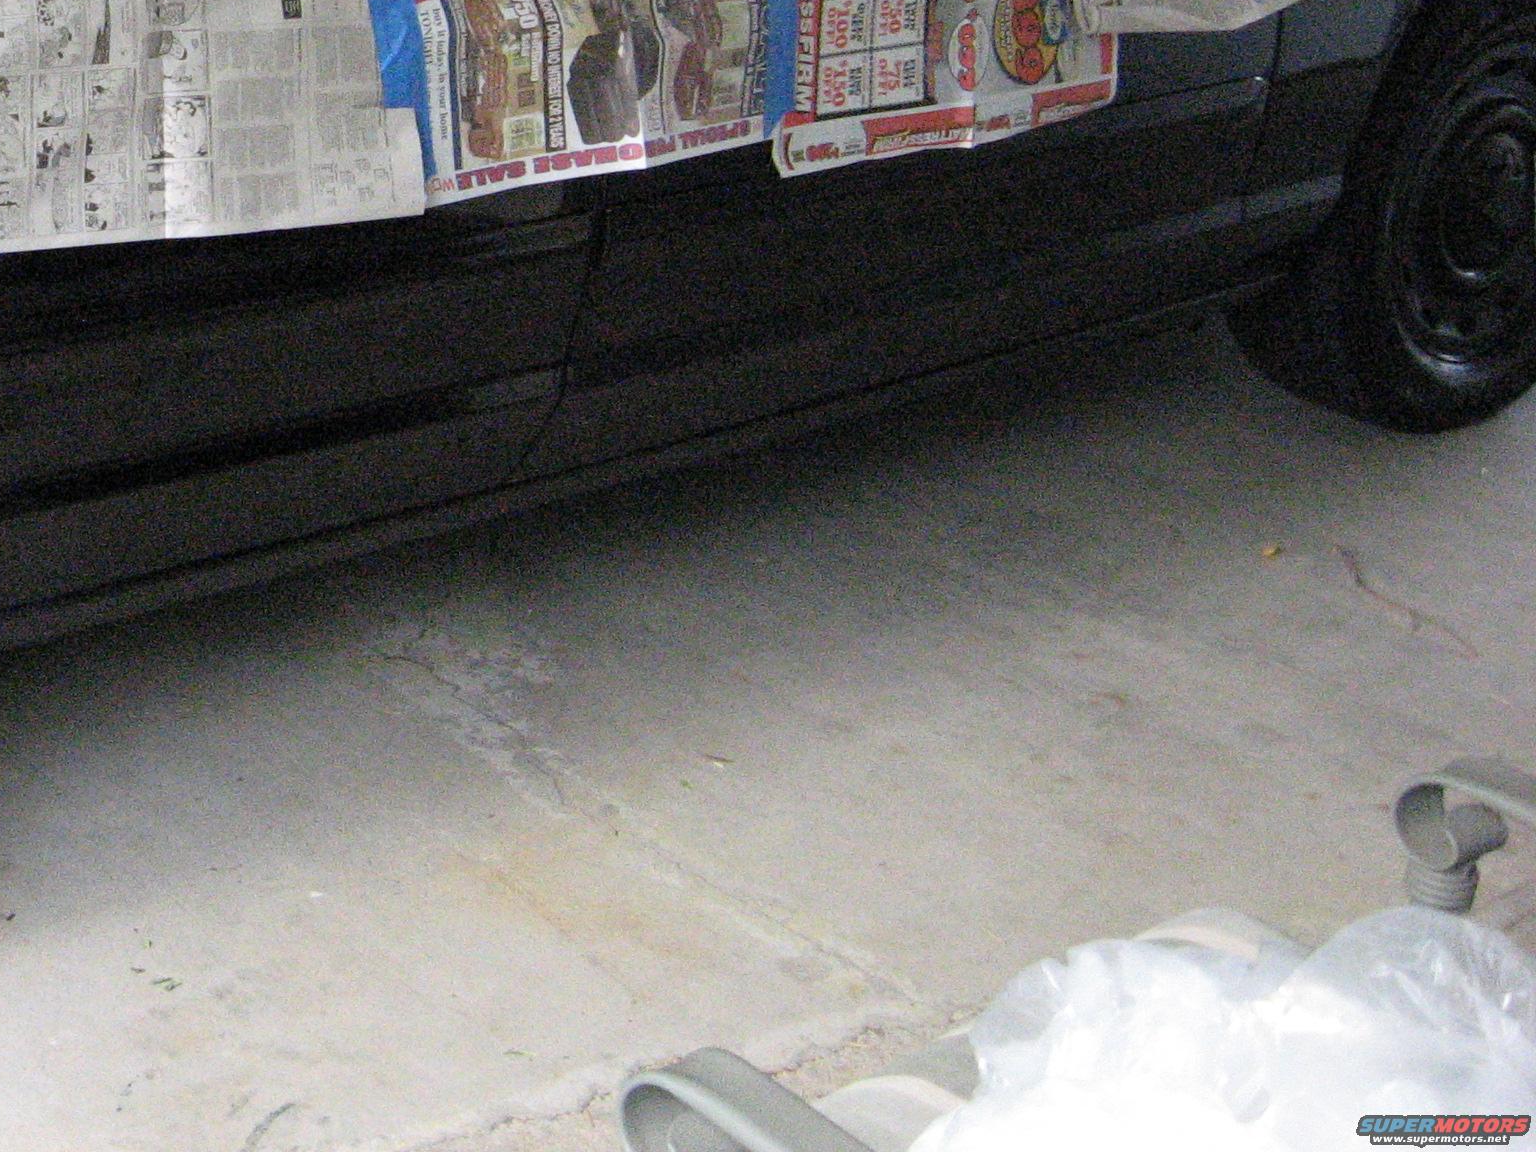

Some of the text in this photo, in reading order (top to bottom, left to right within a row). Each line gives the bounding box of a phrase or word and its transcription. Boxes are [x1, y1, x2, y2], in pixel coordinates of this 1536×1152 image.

[544, 22, 563, 50] DOWN
[831, 0, 854, 50] $100
[546, 49, 560, 66] NO
[547, 65, 561, 98] INTEREST
[829, 60, 852, 107] $150
[885, 59, 904, 90] $75
[548, 98, 562, 116] FOR
[549, 115, 562, 123] 2
[436, 111, 452, 140] home
[549, 122, 564, 150] YEARS
[679, 120, 750, 150] SPECIAL
[455, 160, 527, 191] SALE
